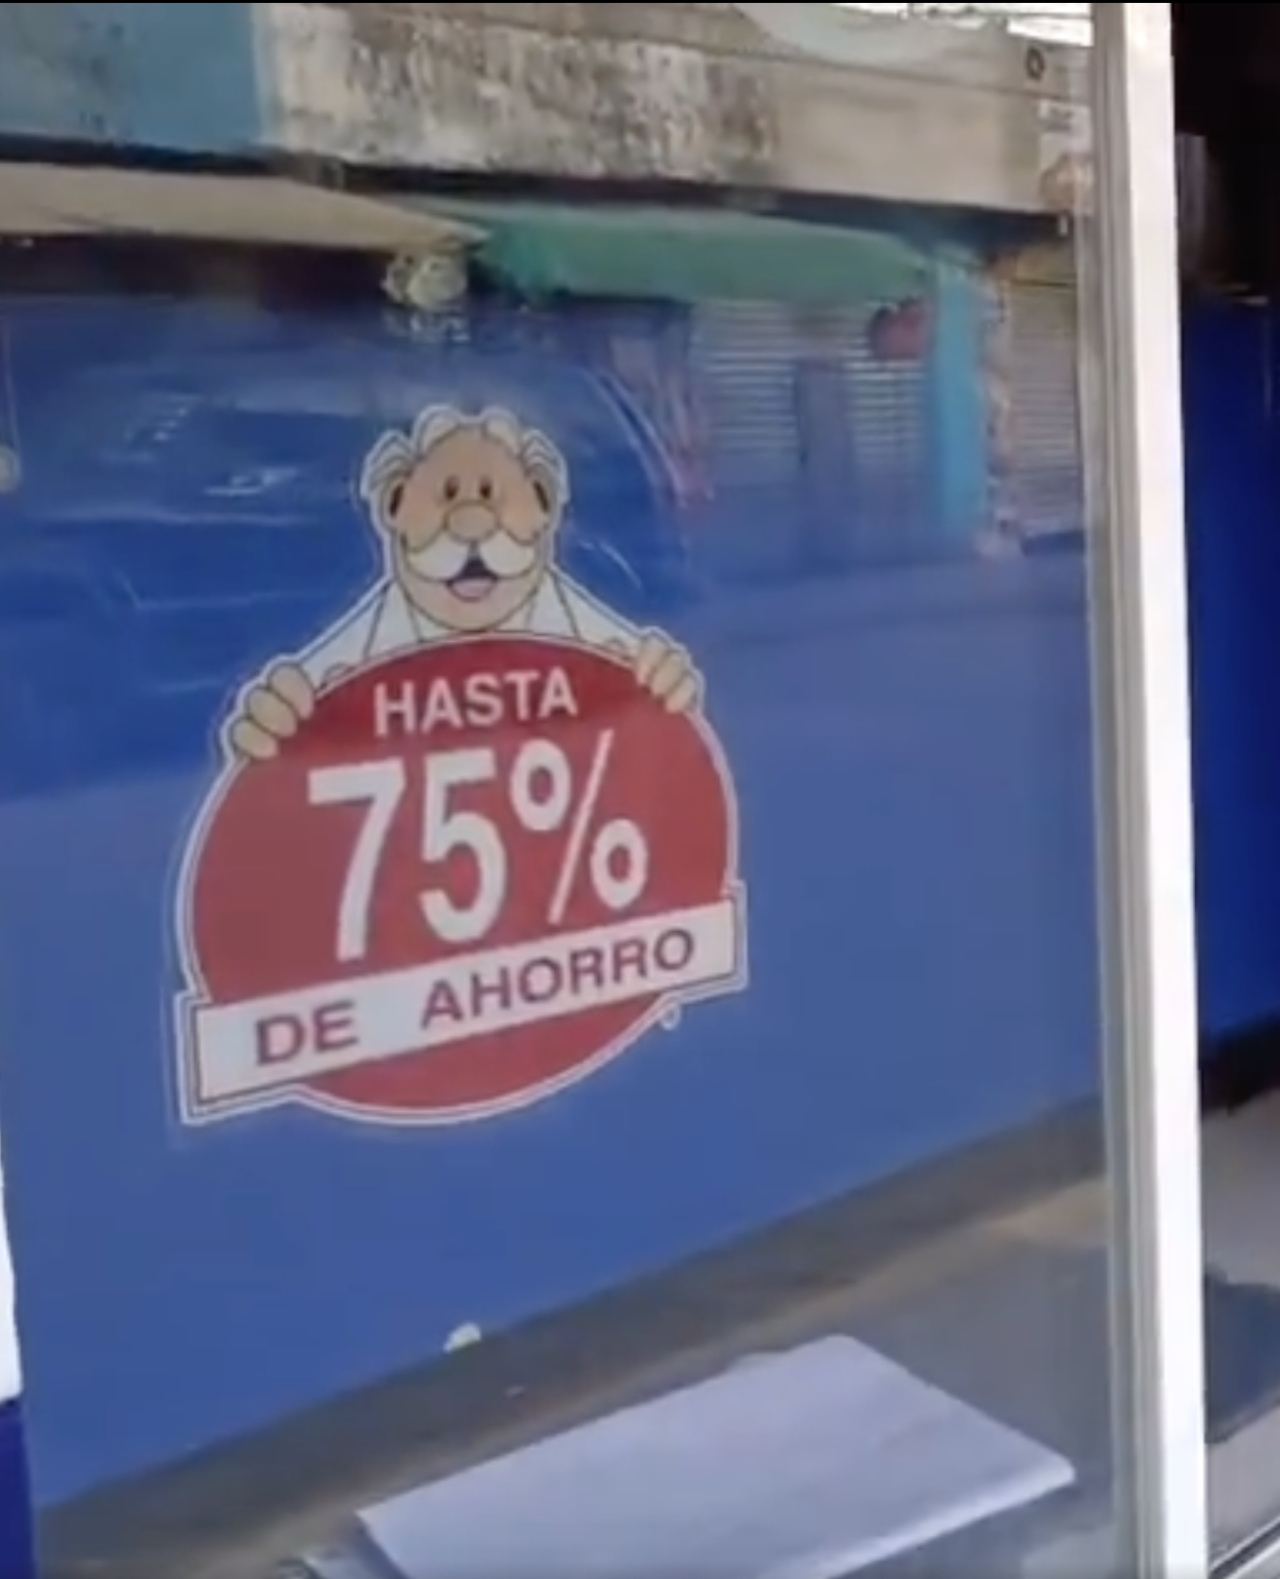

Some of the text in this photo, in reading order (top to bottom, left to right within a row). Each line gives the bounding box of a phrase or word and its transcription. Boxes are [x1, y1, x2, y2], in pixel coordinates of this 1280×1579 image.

[374, 667, 578, 737] HASTA
[308, 729, 648, 962] 75%
[254, 927, 696, 1066] DE AHORRO
